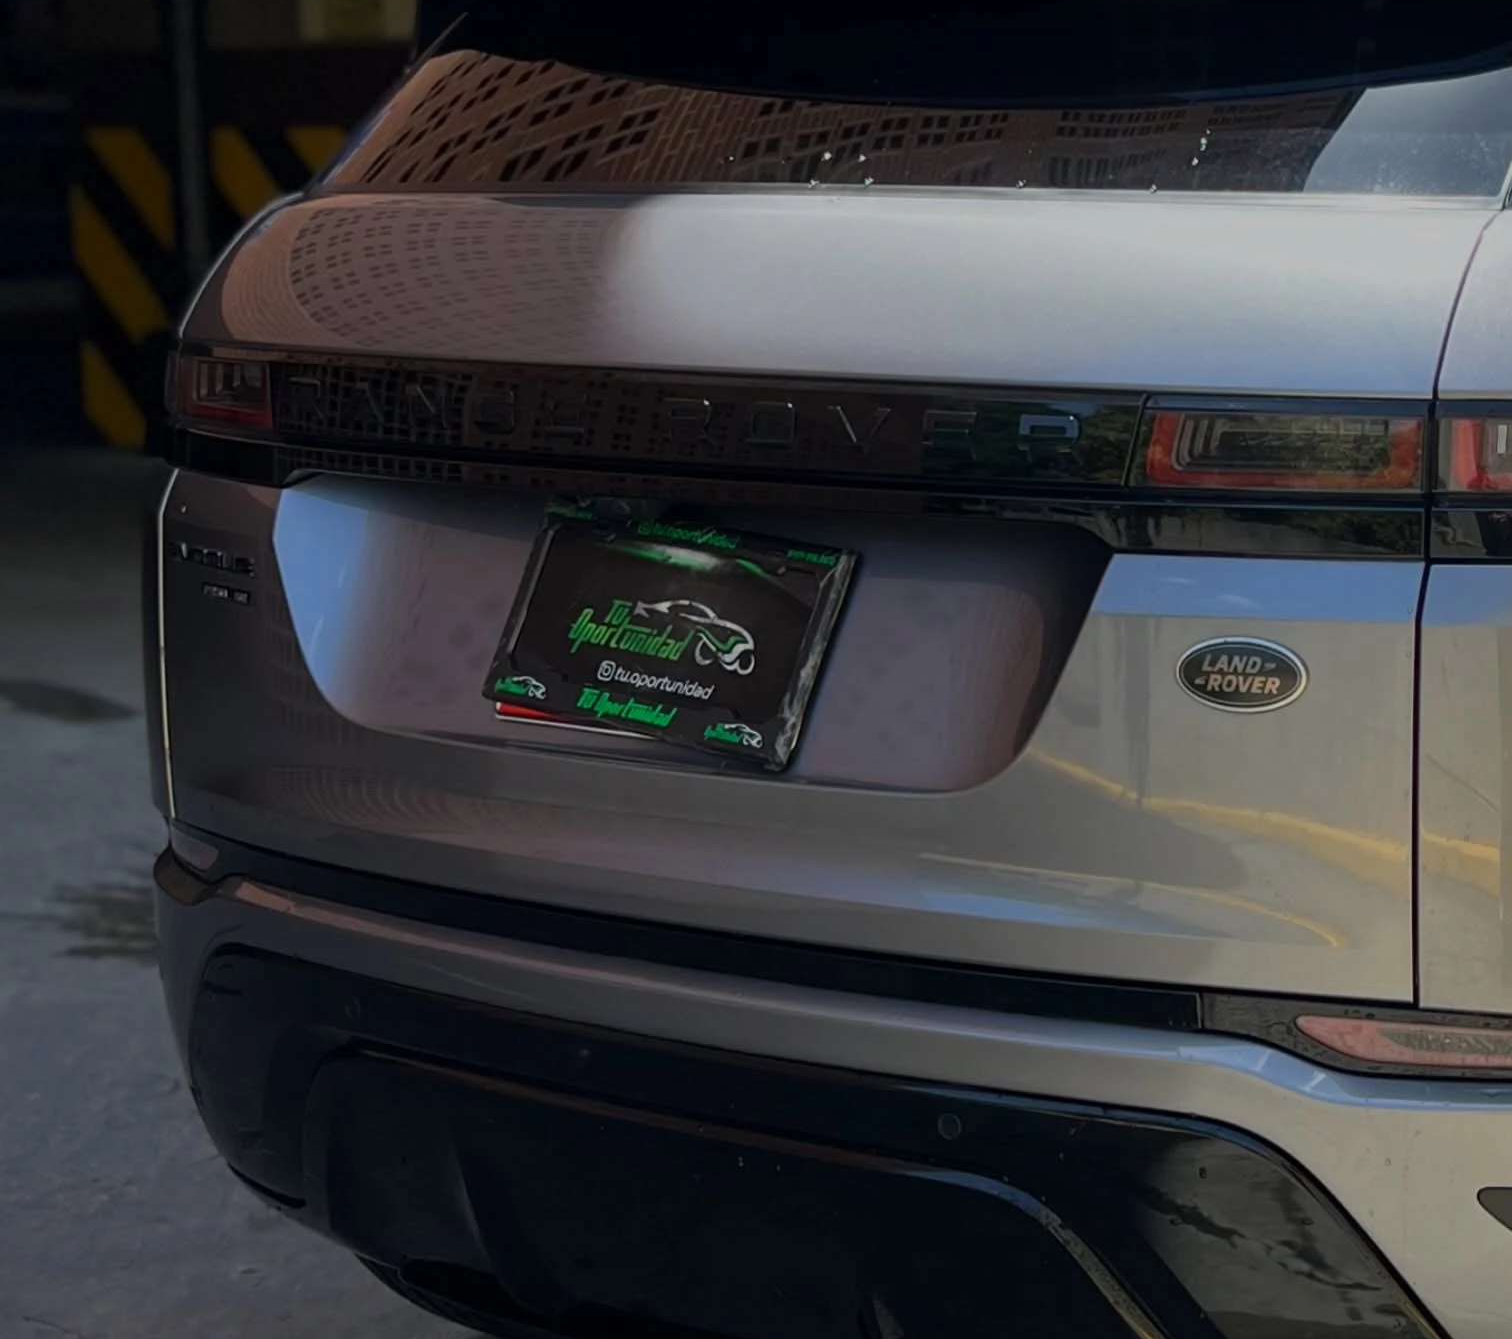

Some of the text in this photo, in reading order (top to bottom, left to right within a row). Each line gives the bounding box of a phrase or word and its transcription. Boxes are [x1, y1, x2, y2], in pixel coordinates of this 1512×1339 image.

[658, 396, 1082, 464] ROVER
[568, 606, 697, 662] Oportunidad
[1200, 653, 1263, 674] LAND
[1206, 673, 1281, 695] ROVER
